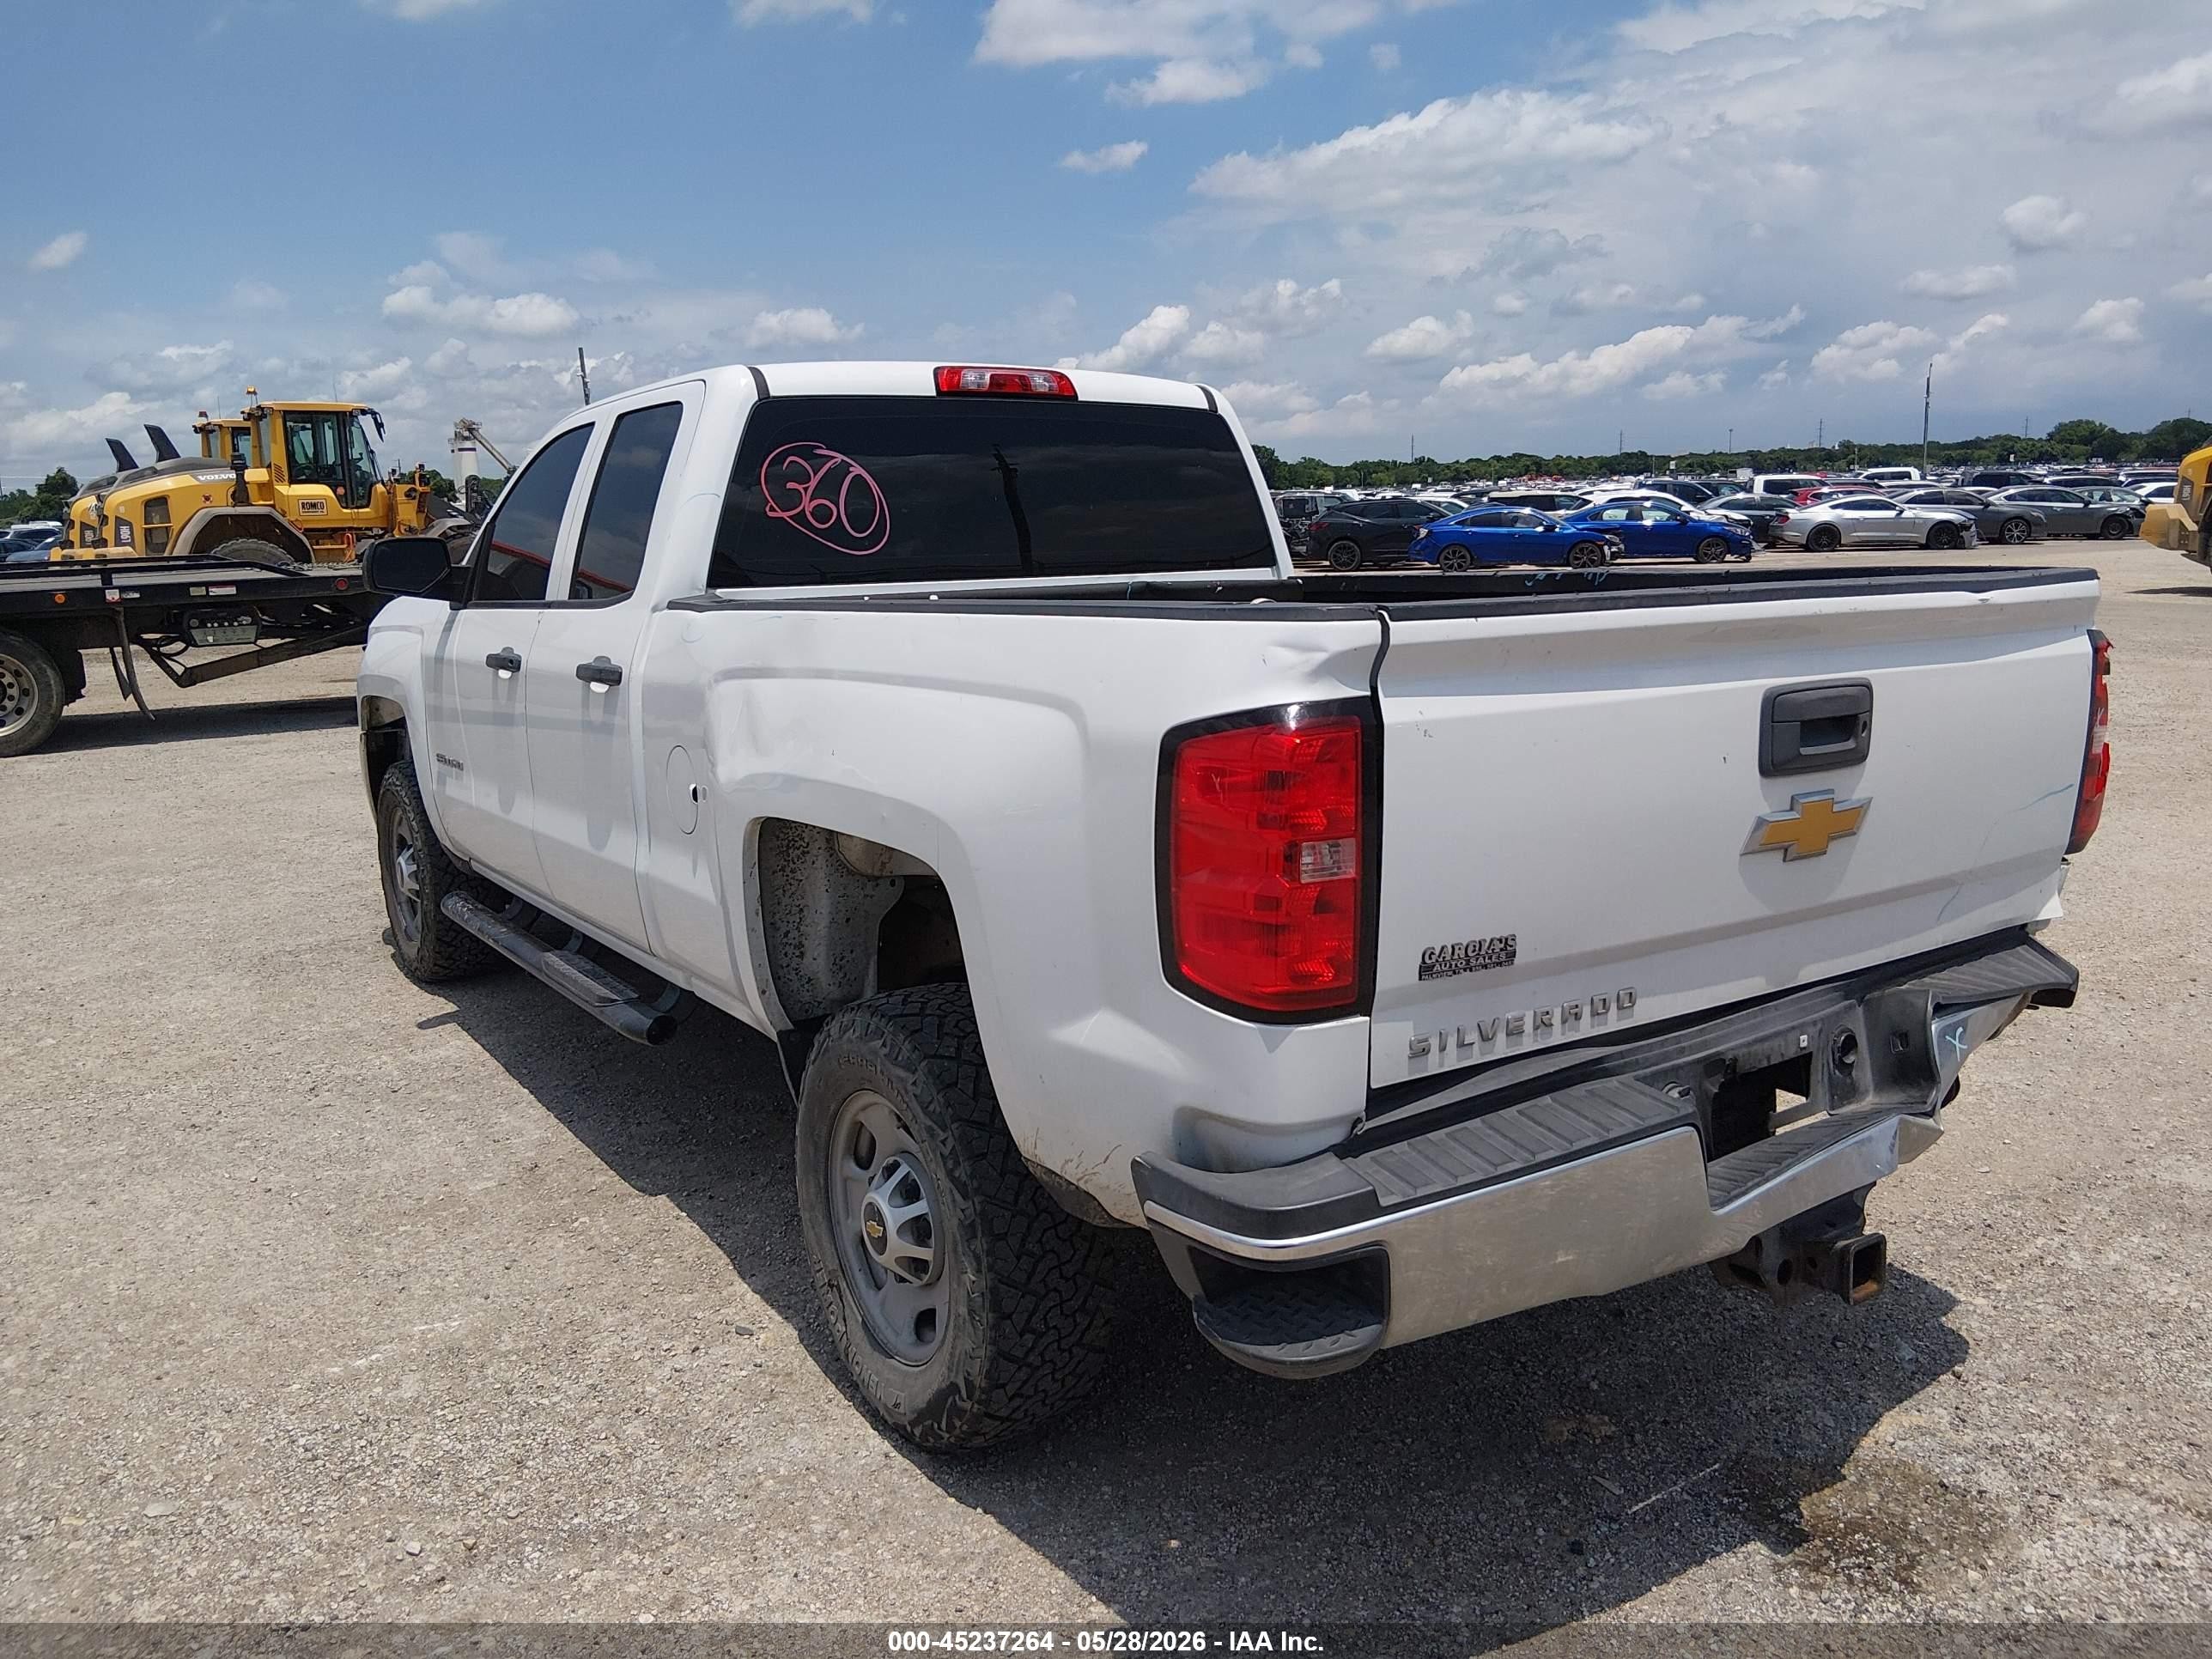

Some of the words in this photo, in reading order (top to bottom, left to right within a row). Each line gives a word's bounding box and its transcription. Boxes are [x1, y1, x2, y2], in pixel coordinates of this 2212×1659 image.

[301, 501, 325, 511] ROMCO
[765, 456, 880, 538] 360
[119, 526, 131, 543] L90H
[1432, 960, 1466, 973] AUTO
[1468, 951, 1507, 967] SALES
[1407, 987, 1638, 1058] SILVERADO
